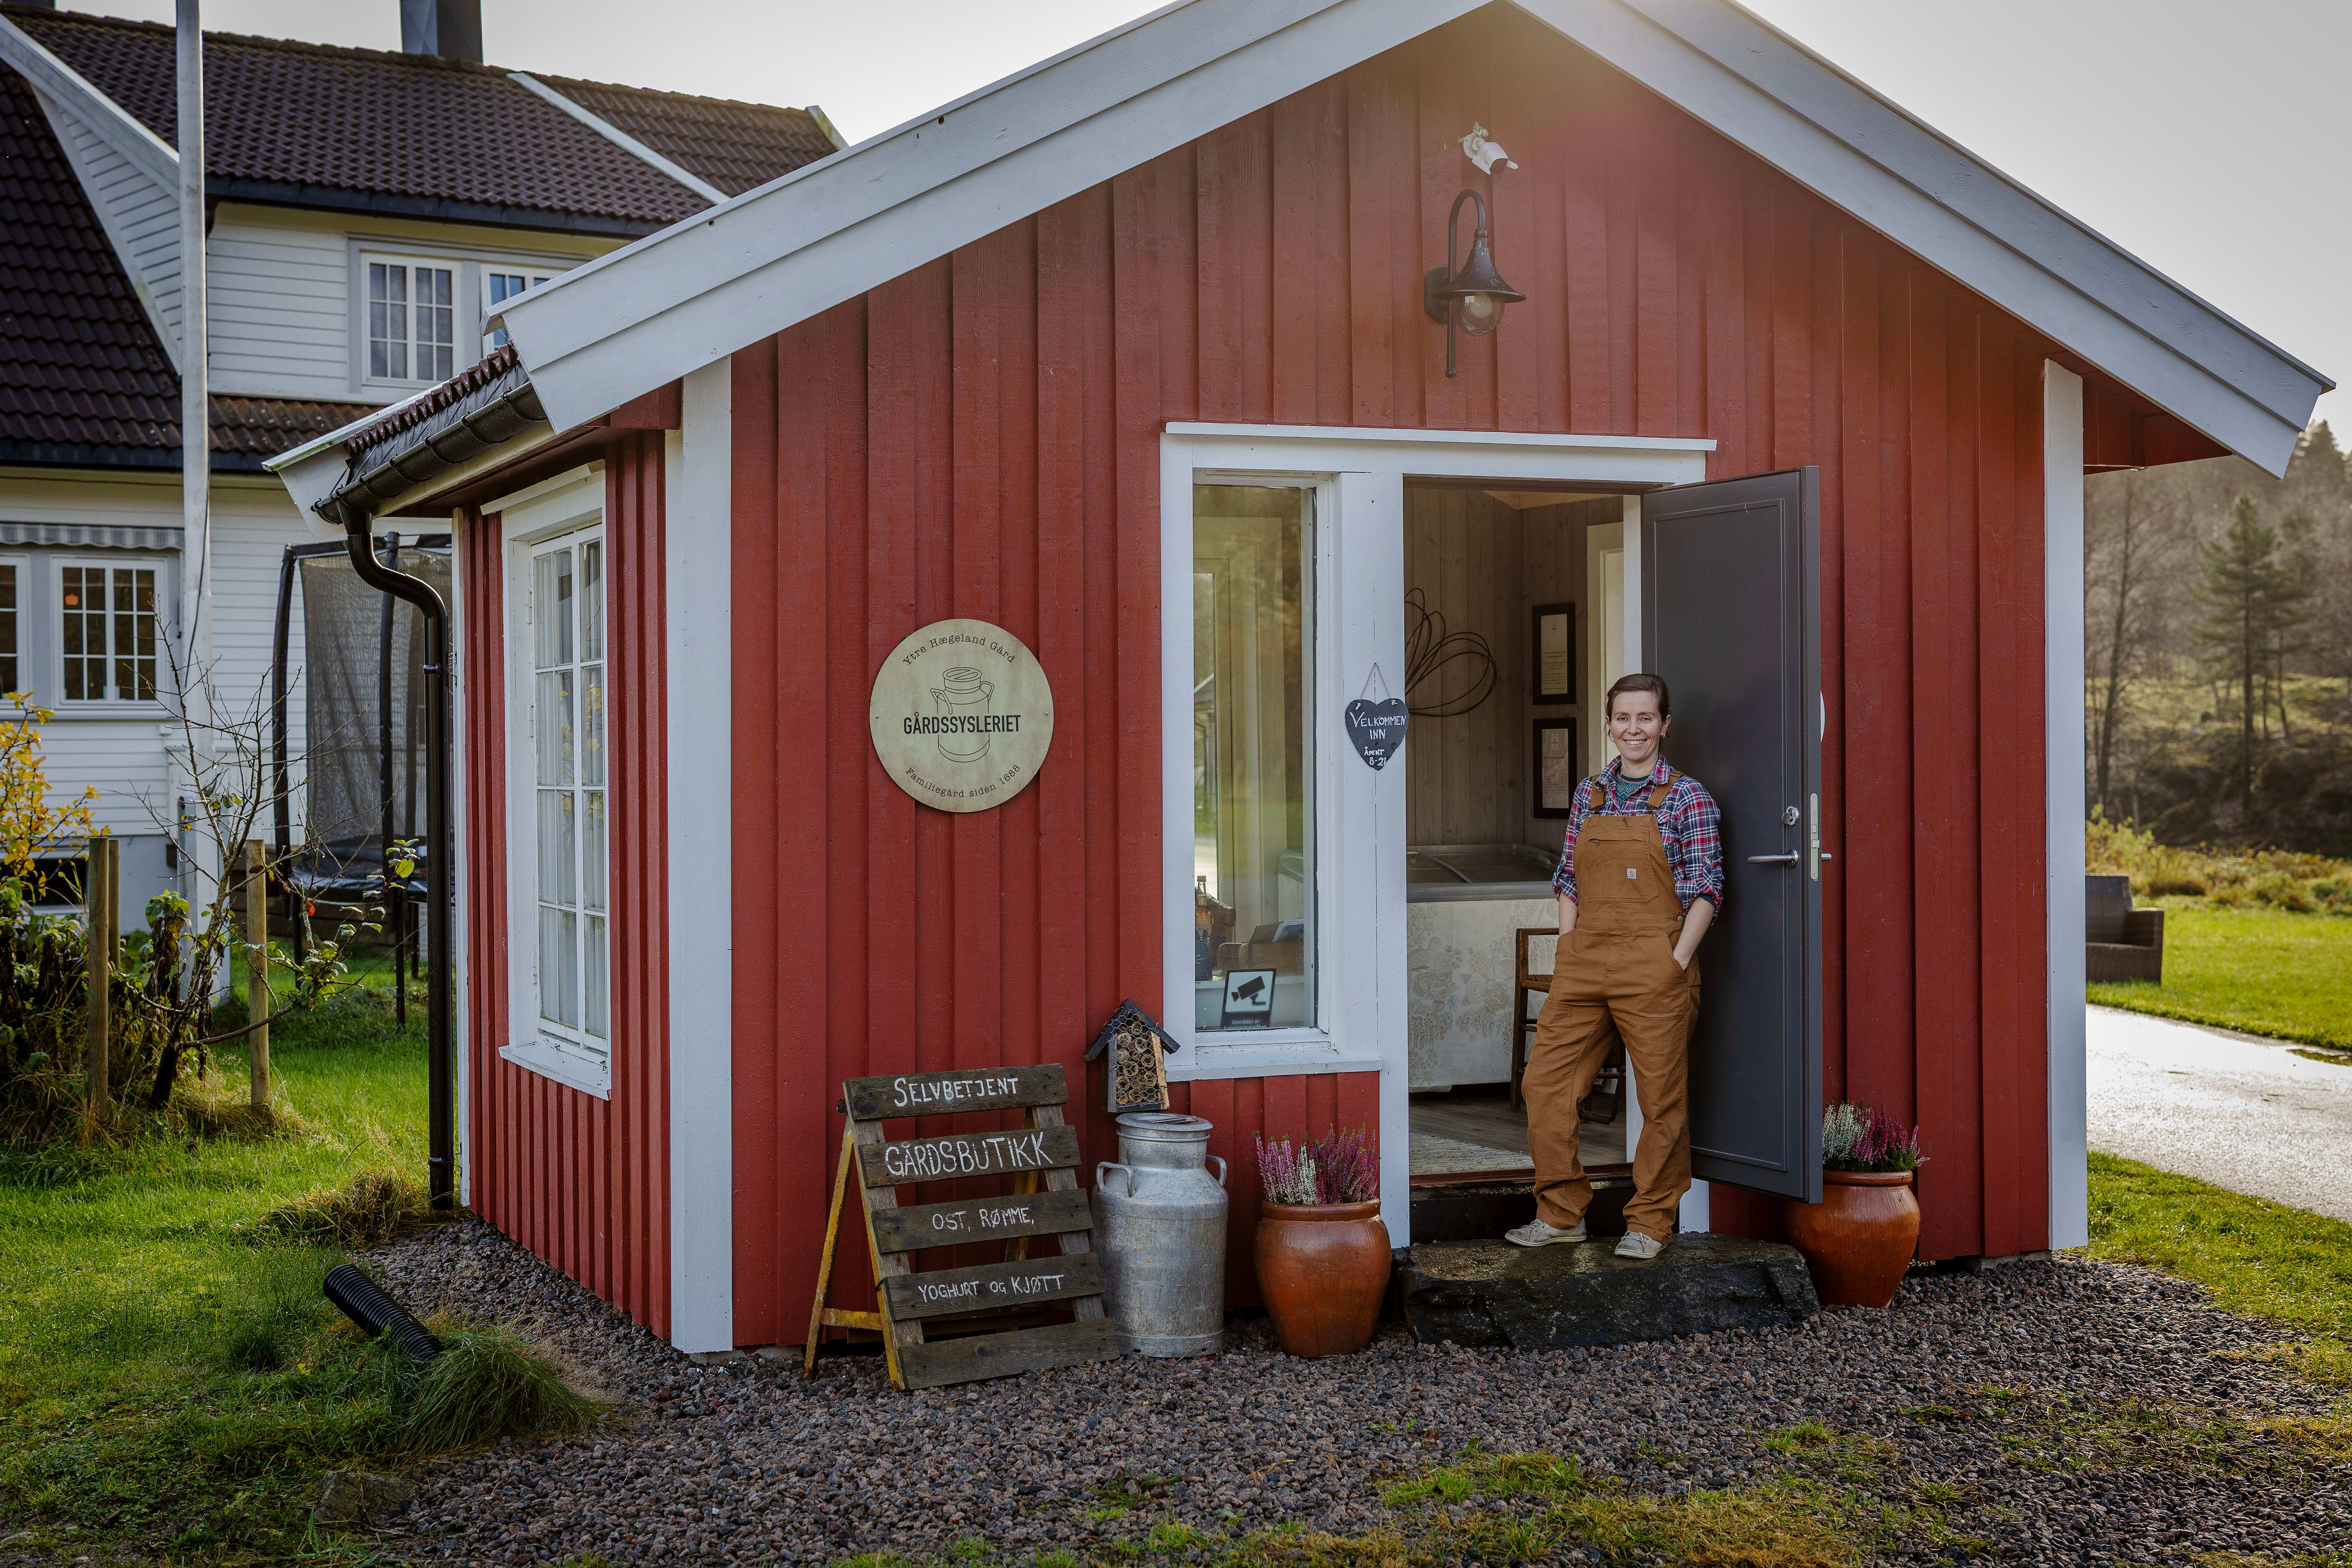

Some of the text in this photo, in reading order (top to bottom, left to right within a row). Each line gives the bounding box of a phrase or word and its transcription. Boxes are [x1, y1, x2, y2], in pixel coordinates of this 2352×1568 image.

[903, 633, 1015, 665] Ytre Hægeland Gård
[904, 711, 1021, 735] GÅRDSSYSLERIET
[1349, 711, 1407, 728] VELKOMMEN
[1369, 728, 1386, 740] INN
[1364, 746, 1385, 756] ÅPENT
[1369, 757, 1387, 766] 8-21
[905, 765, 1020, 799] Familiegård siden 1688
[894, 1077, 1018, 1107] SELVBETJENT
[885, 1131, 1053, 1177] GÅRDSBUTIKK
[932, 1207, 1034, 1232] OST, RØMME,
[918, 1274, 1065, 1303] YOGHURT OG KJØTT
